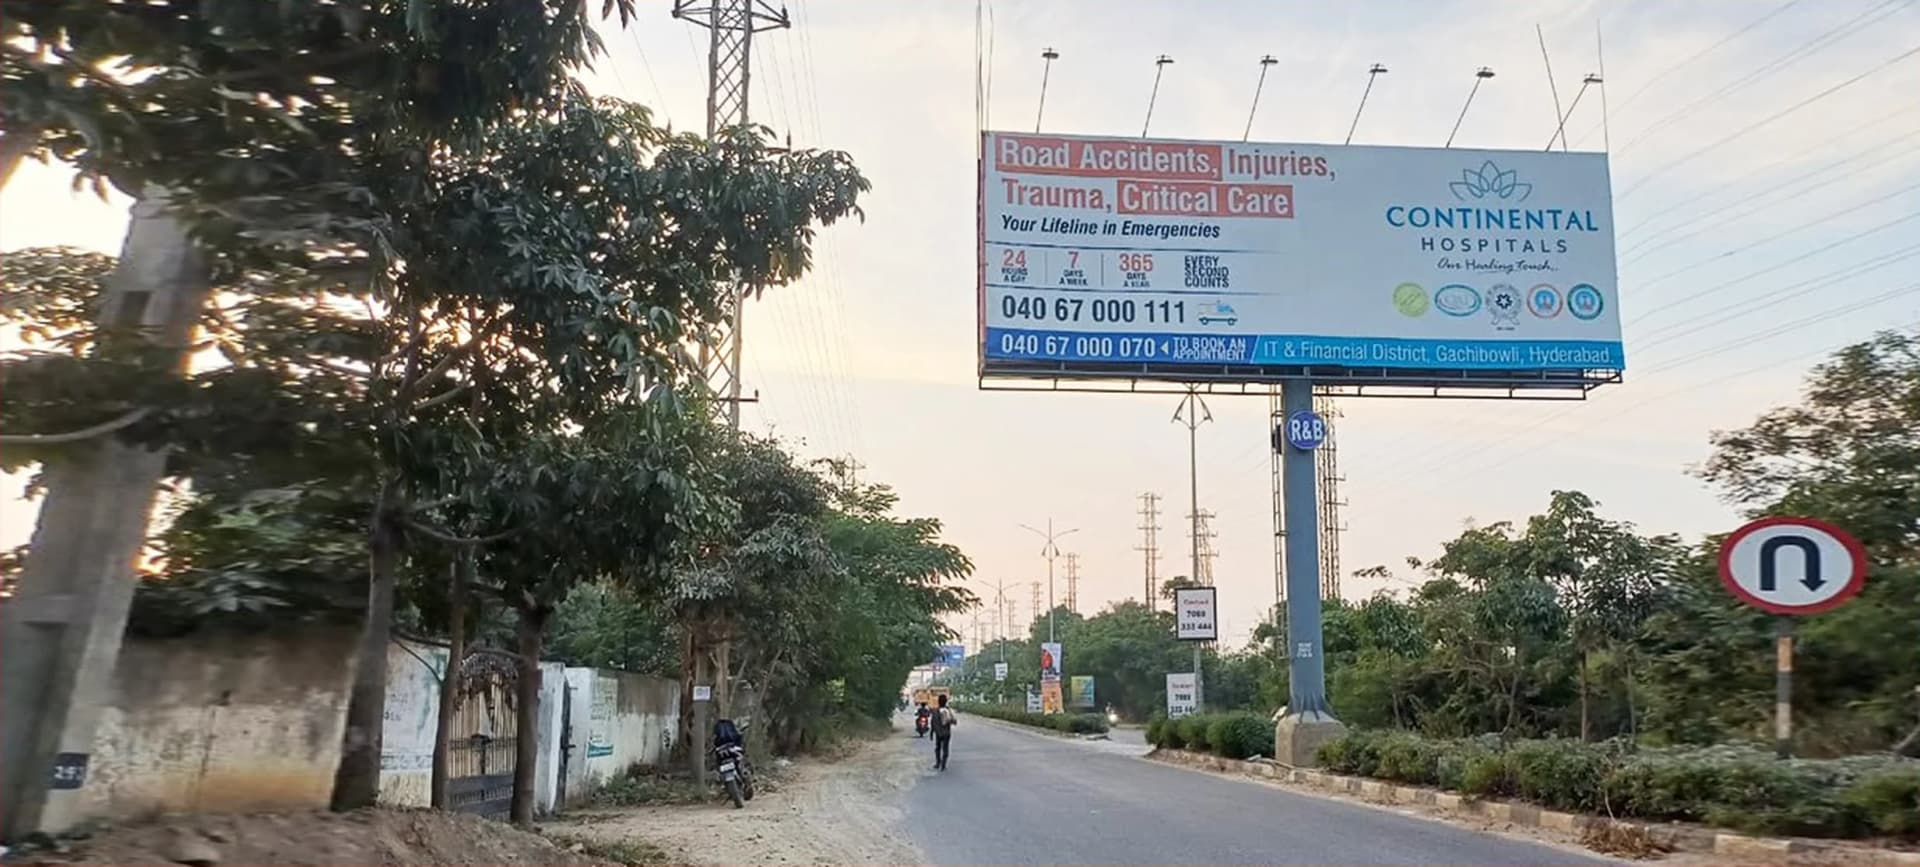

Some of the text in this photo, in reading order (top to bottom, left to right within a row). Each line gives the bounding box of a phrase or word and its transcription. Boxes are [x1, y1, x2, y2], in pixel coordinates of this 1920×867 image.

[1001, 137, 1335, 181] Road Accidents, Injuries,
[1002, 178, 1289, 214] Trauma, Critical Care
[1001, 214, 1220, 240] Your Lifeline in Emergencies
[1386, 205, 1600, 232] CONTINENTAL
[1421, 237, 1568, 253] HOSPITALS
[1003, 249, 1027, 268] 24
[1067, 251, 1080, 269] 7
[1119, 253, 1154, 273] 365
[1184, 256, 1220, 267] EVERY
[1437, 257, 1462, 272] Our
[1465, 258, 1514, 274] Healing
[1063, 269, 1084, 278] DAYS
[1126, 272, 1147, 280] DAYS
[1184, 266, 1230, 277] SECOND
[1184, 277, 1230, 288] COUNTS
[1002, 295, 1186, 324] 040 67 000 111
[1002, 333, 1156, 358] 040 67 000 070
[1173, 337, 1246, 351] TO BOOK AN
[1173, 349, 1246, 361] APPOINTMENT
[1264, 340, 1615, 367] IT & Financial District, Gachibowli, Hyderabad.
[1291, 419, 1323, 441] R&B
